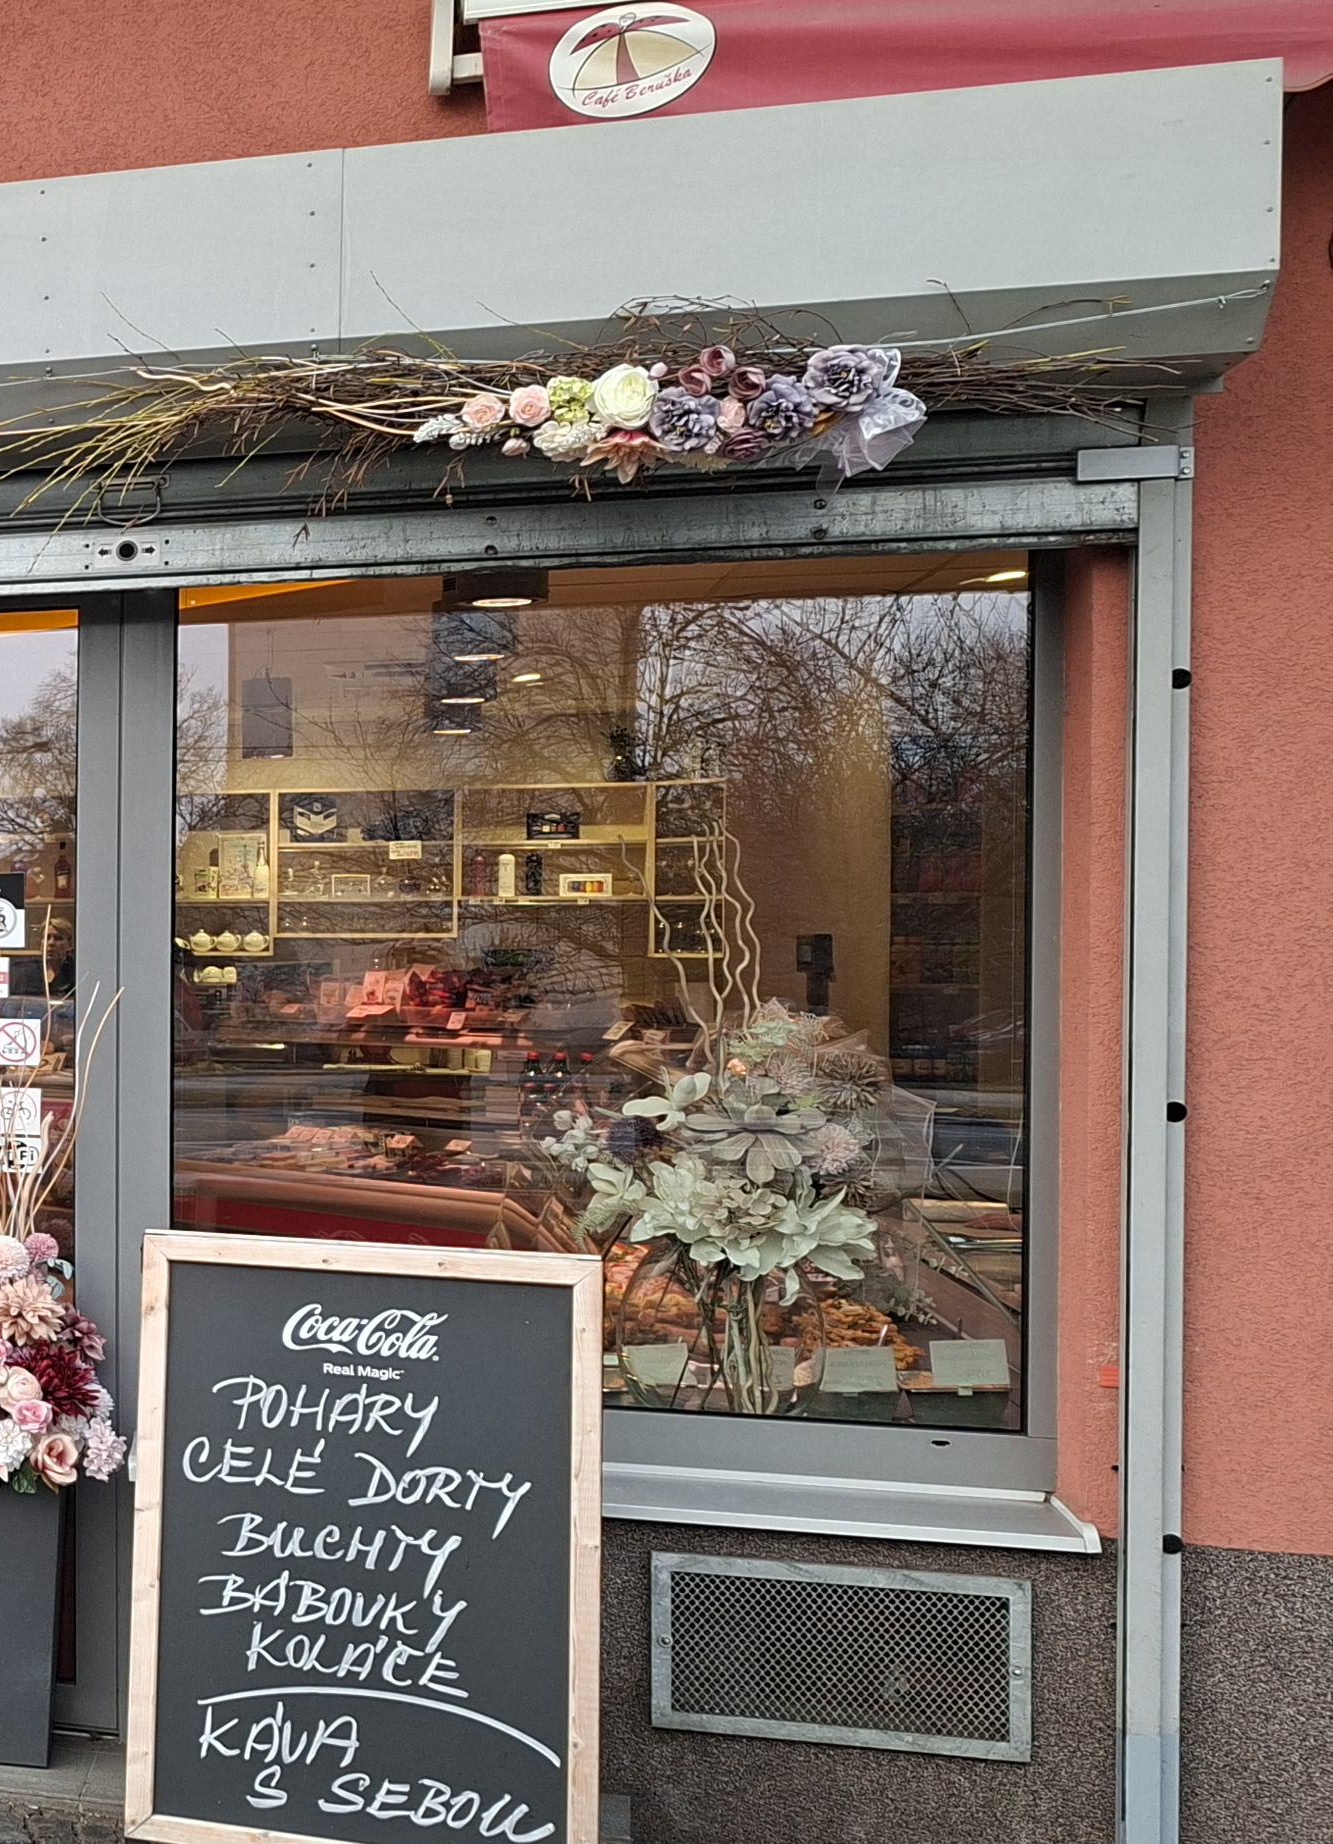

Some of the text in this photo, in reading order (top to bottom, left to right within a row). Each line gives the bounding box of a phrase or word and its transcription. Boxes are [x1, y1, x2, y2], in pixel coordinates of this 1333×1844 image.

[582, 67, 693, 109] Café Beruška
[282, 1303, 449, 1361] Coca-Cola
[323, 1362, 355, 1376] Real
[182, 1436, 533, 1540] CELÉ DORTY
[217, 1512, 463, 1600] BUCHTY
[198, 1701, 361, 1768] KÁVA
[245, 1765, 556, 1843] S SEBOU
